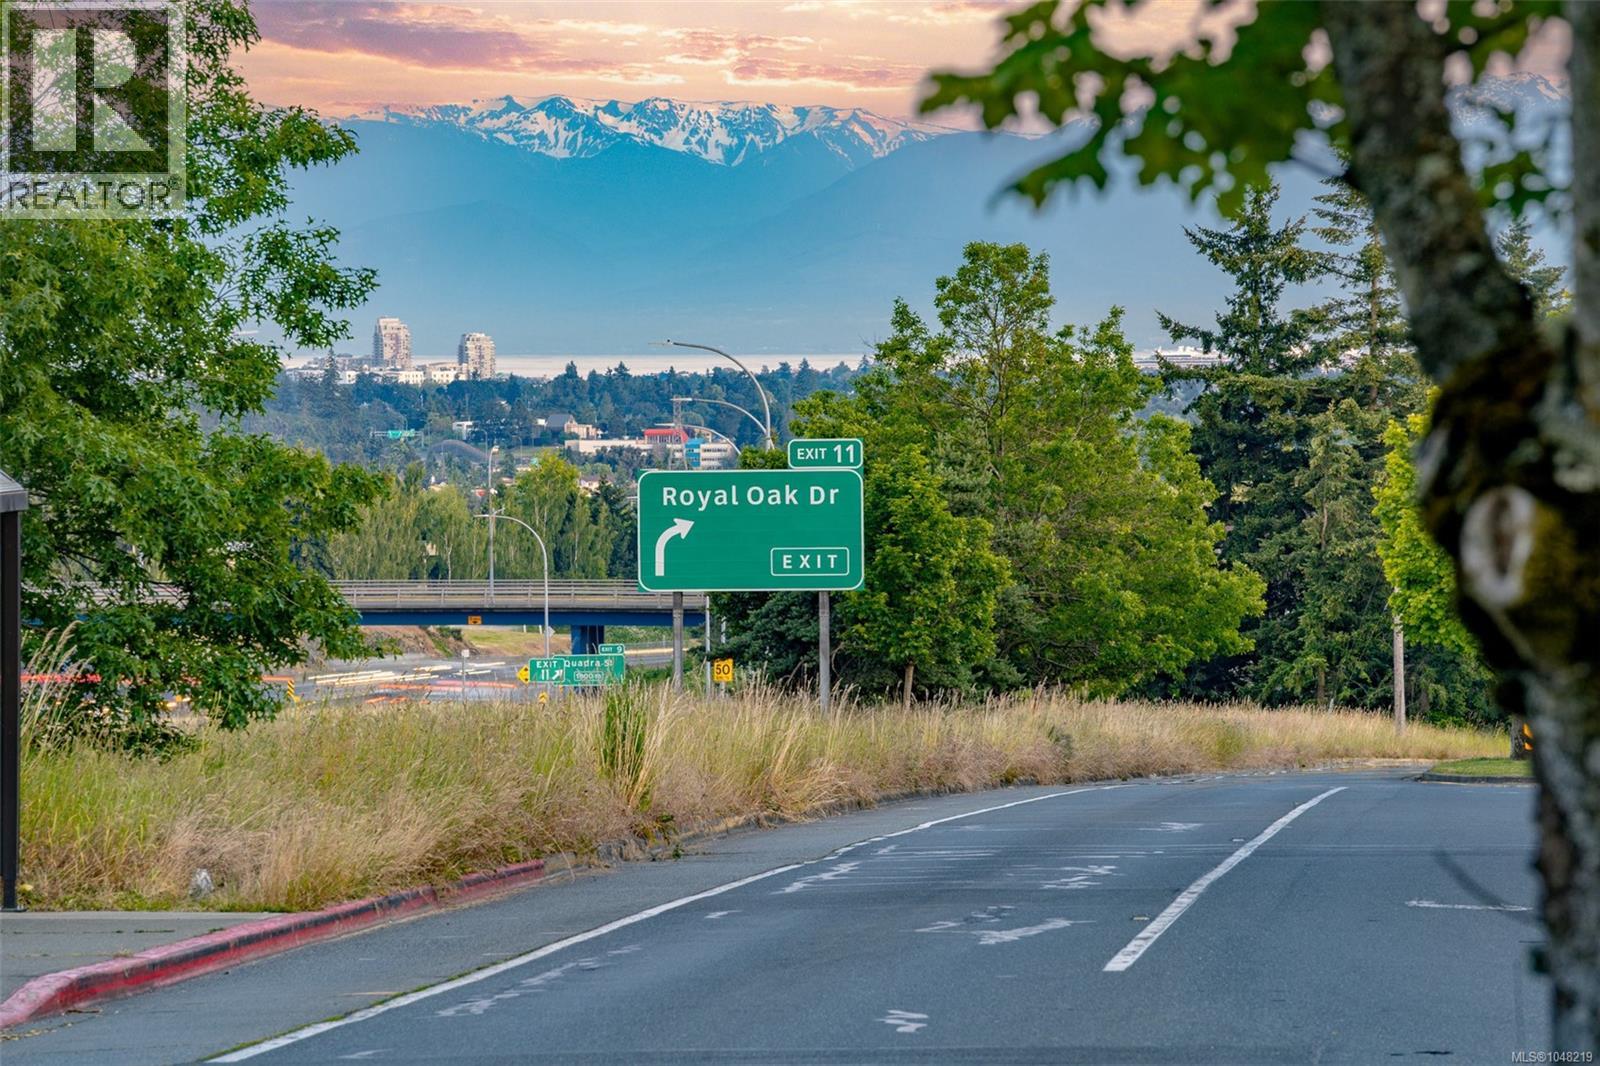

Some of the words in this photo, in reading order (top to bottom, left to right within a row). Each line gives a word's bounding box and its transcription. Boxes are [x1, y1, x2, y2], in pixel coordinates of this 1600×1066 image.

[797, 447, 827, 460] EXIT
[833, 444, 854, 463] 11
[662, 485, 739, 511] Royal
[746, 485, 799, 506] Oak
[809, 486, 840, 505] Dr
[782, 554, 838, 569] EXIT
[616, 645, 622, 654] 9
[536, 660, 558, 669] EXIT
[564, 659, 601, 668] Quadra
[715, 663, 731, 675] 50
[541, 669, 550, 681] 11
